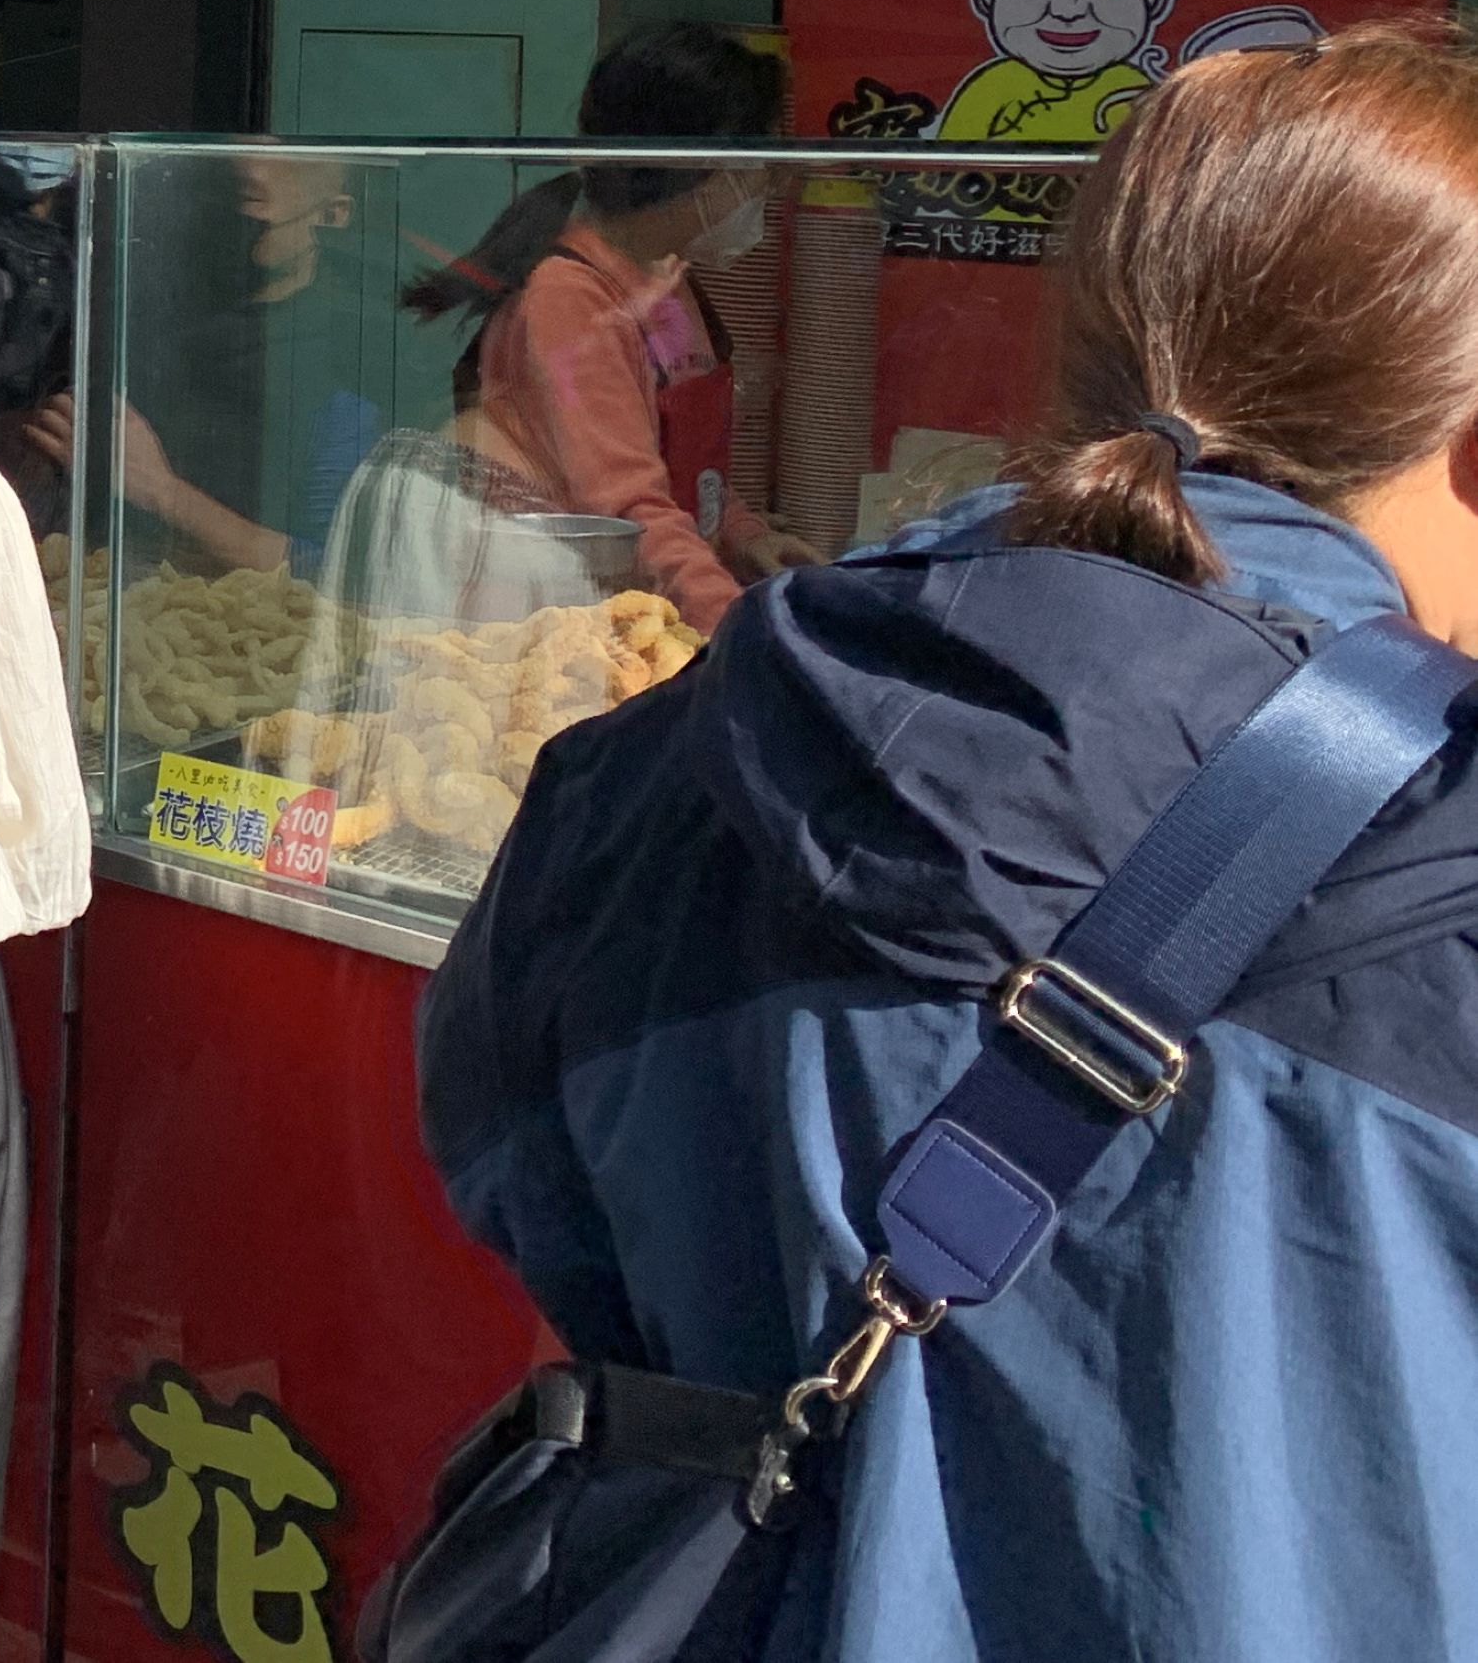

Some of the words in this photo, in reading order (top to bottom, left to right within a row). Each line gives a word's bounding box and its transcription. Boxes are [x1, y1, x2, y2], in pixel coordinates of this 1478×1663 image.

[155, 786, 270, 861] 花枝燒
[280, 804, 330, 839] $100
[274, 840, 324, 875] $150
[122, 1380, 339, 1663] 花
